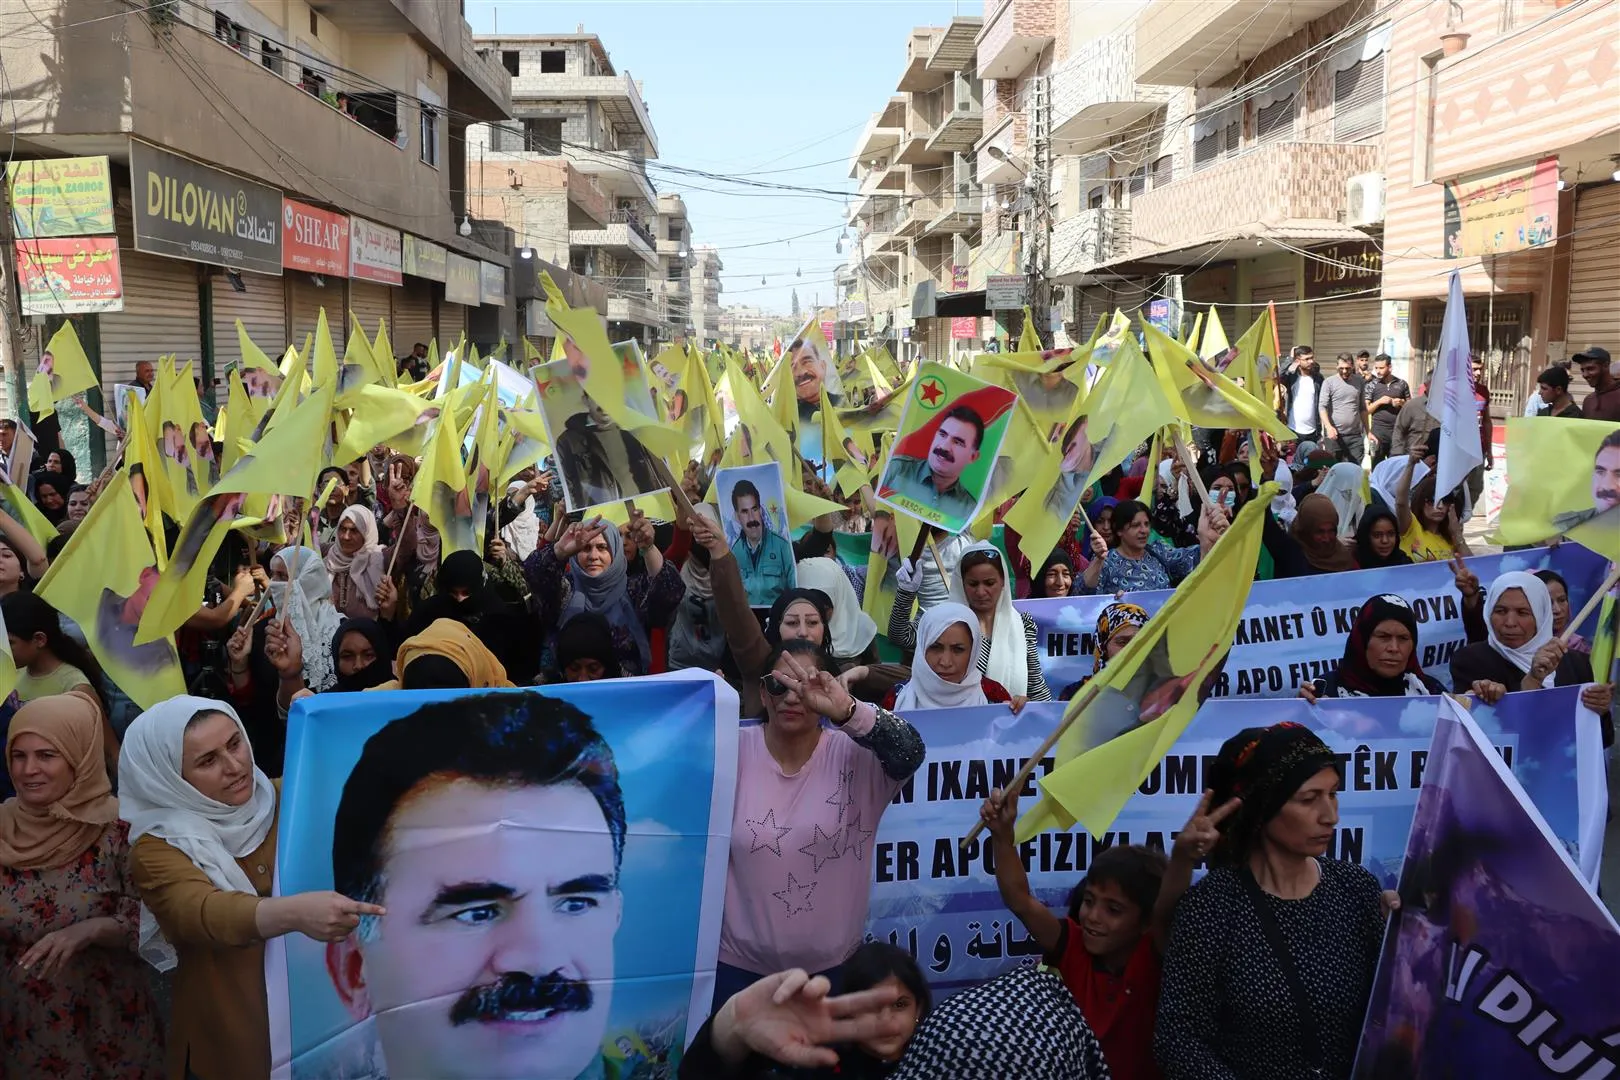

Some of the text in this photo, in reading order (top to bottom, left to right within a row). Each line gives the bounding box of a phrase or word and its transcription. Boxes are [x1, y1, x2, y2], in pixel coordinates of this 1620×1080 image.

[147, 171, 235, 236] DILOVAN
[235, 215, 276, 245] اتصالات
[295, 213, 340, 251] SHEAR
[1231, 612, 1304, 646] XANET
[1311, 606, 1328, 637] Û
[1236, 665, 1283, 696] APO
